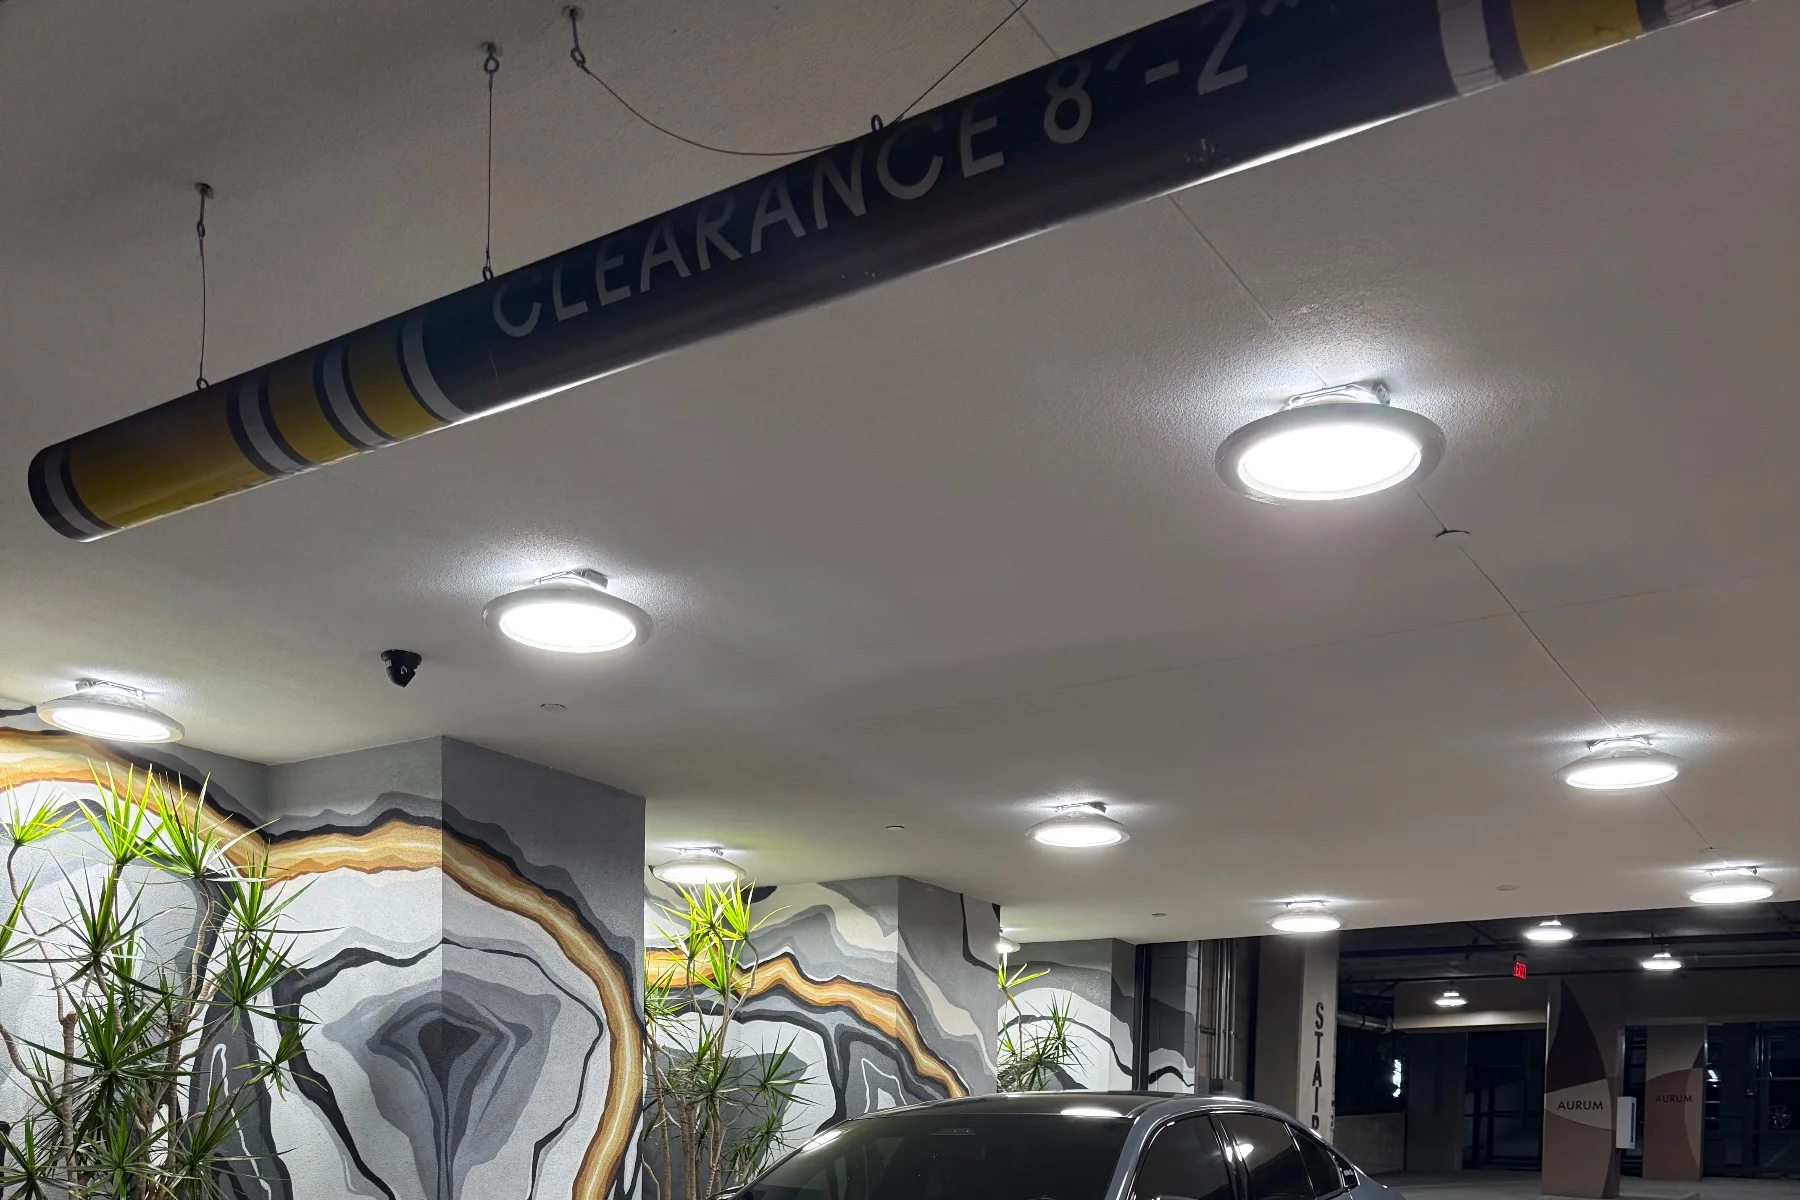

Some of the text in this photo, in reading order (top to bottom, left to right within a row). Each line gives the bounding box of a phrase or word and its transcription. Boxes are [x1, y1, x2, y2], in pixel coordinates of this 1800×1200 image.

[492, 95, 1006, 339] CLEARANCE
[1654, 1094, 1693, 1103] AURUM
[1556, 1100, 1603, 1111] AURUM
